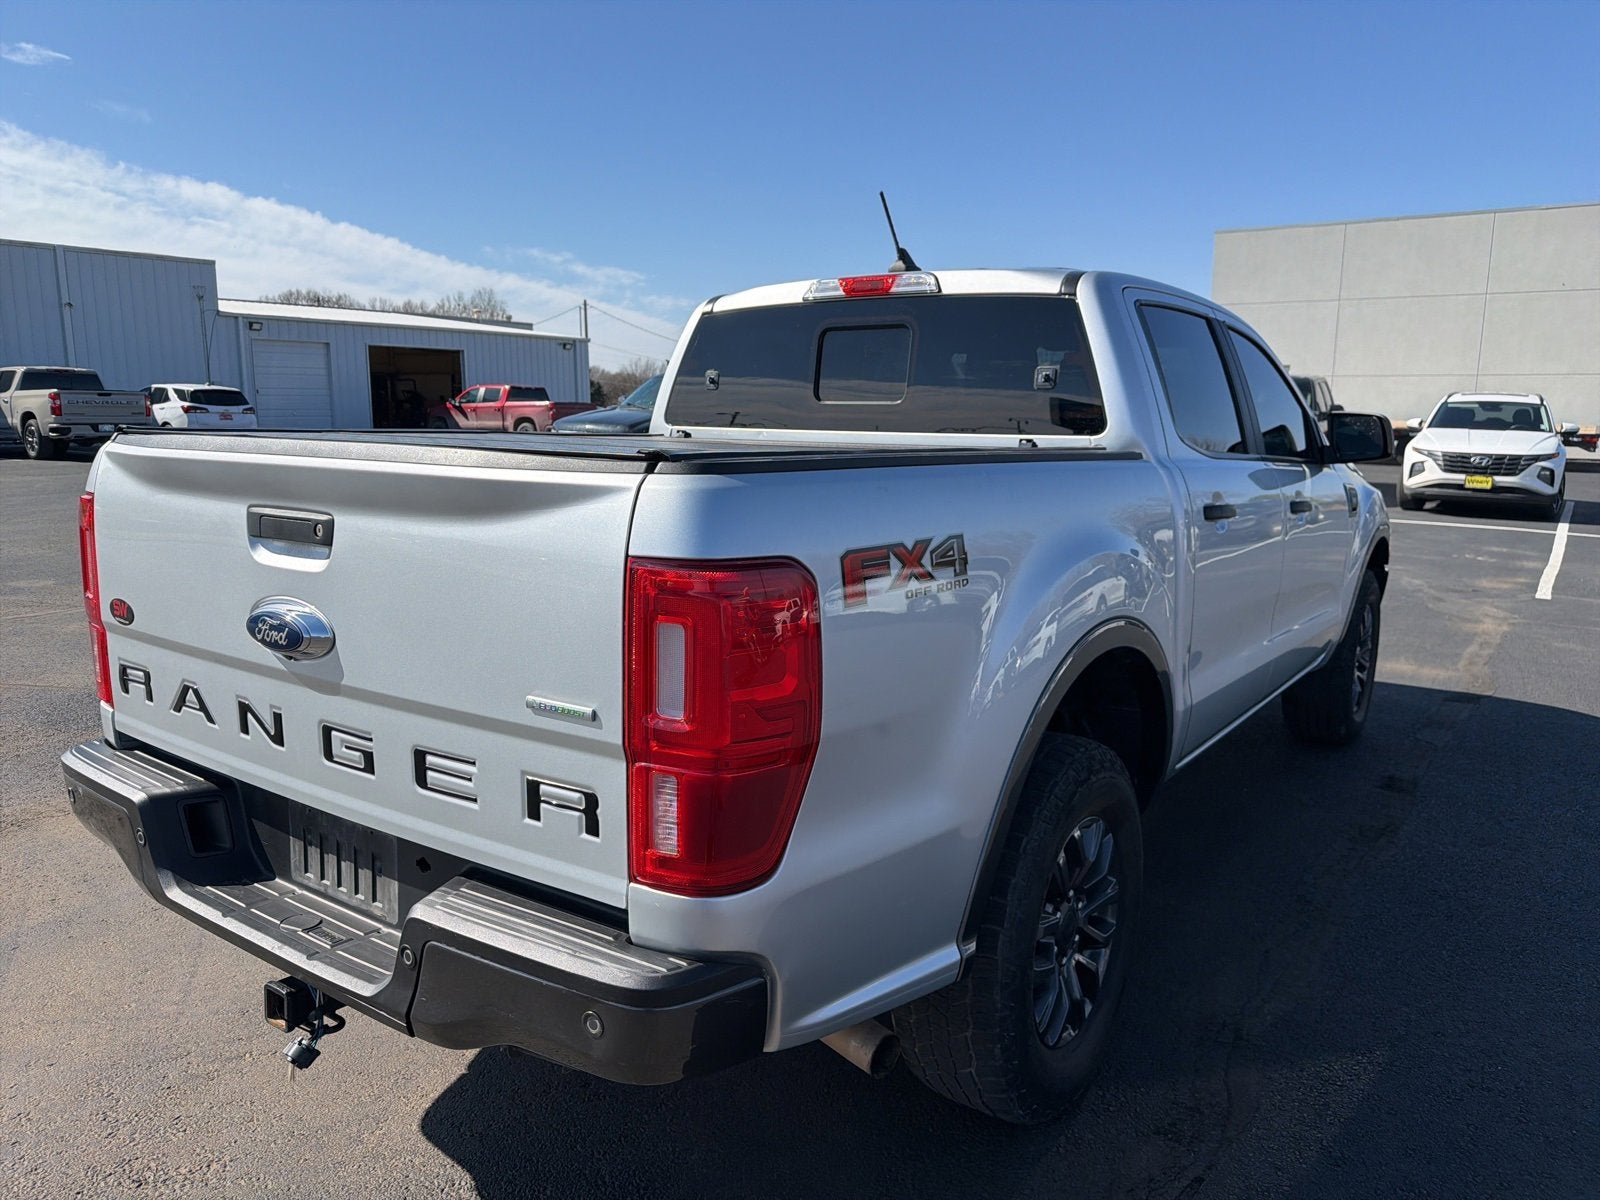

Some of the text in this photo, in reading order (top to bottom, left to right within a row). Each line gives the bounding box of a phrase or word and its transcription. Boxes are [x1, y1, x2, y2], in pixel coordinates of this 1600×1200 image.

[840, 533, 968, 609] FX4
[904, 578, 969, 600] OFF ROAD
[255, 616, 289, 646] Ford
[118, 662, 600, 840] RANGER
